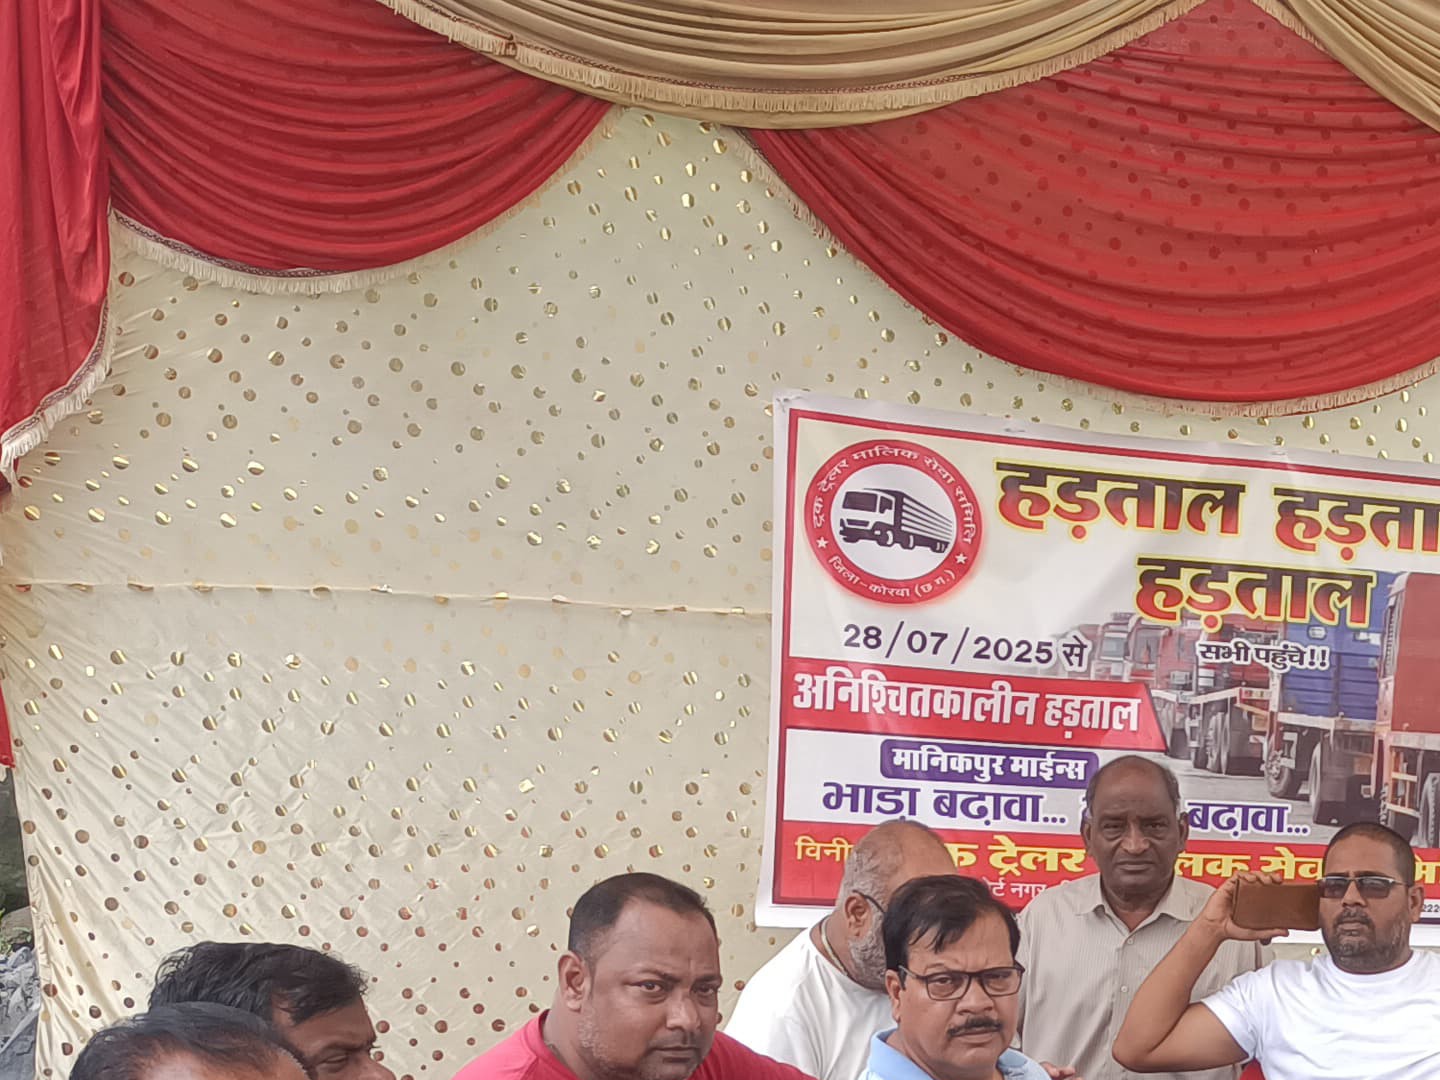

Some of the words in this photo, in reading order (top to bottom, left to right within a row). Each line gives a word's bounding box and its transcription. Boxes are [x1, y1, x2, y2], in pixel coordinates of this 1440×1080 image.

[852, 444, 920, 460] मालिक
[923, 455, 955, 485] सेवा
[955, 485, 977, 545] समिति
[994, 458, 1247, 541] हड़ताल
[1134, 554, 1378, 632] हड़ताल
[843, 621, 1054, 665] 28/07/2025
[1062, 634, 1089, 667] से
[1198, 641, 1250, 662] सभी
[792, 666, 1040, 726] अनिश्चितकालीन
[1044, 693, 1142, 739] हड़ताल
[892, 744, 1005, 781] मानिकपुर
[1010, 750, 1087, 781] माईन्स
[794, 835, 851, 862] विनी
[987, 835, 1086, 877] ट्रेलर
